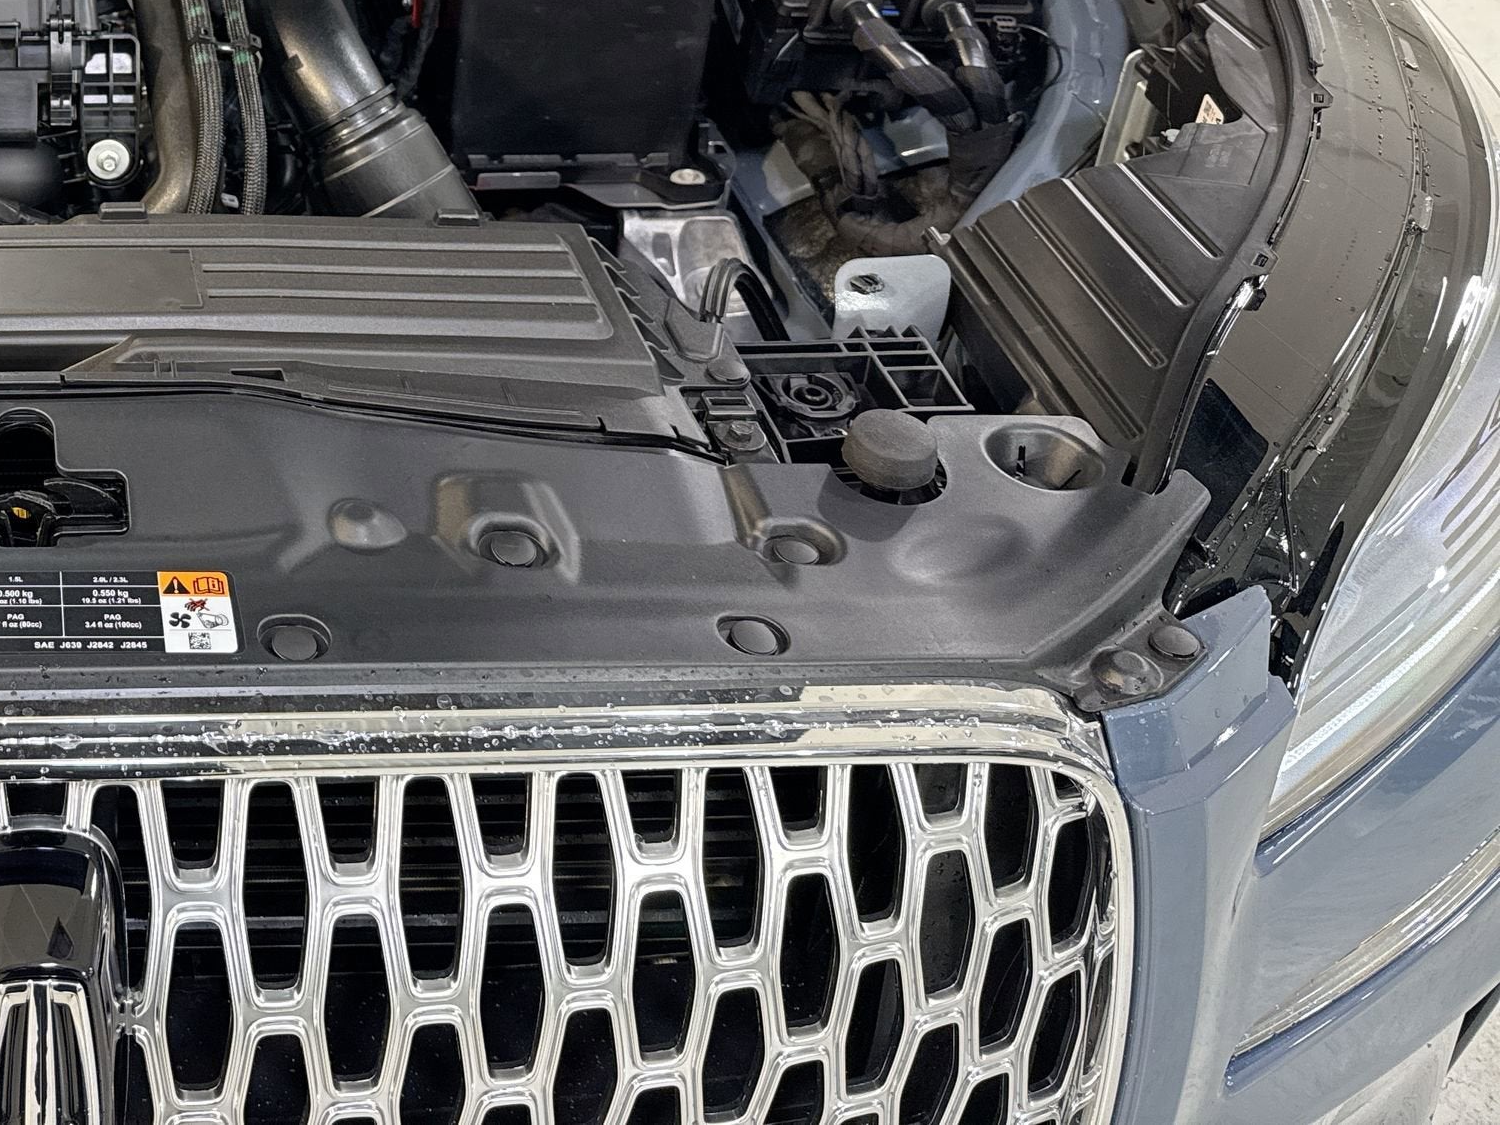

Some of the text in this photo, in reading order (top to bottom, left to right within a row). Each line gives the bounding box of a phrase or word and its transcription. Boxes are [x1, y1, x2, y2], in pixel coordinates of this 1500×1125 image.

[21, 590, 34, 599] kg
[117, 590, 129, 598] kg
[128, 597, 141, 605] lbs)
[87, 641, 114, 649] J2842
[120, 641, 147, 649] J2845
